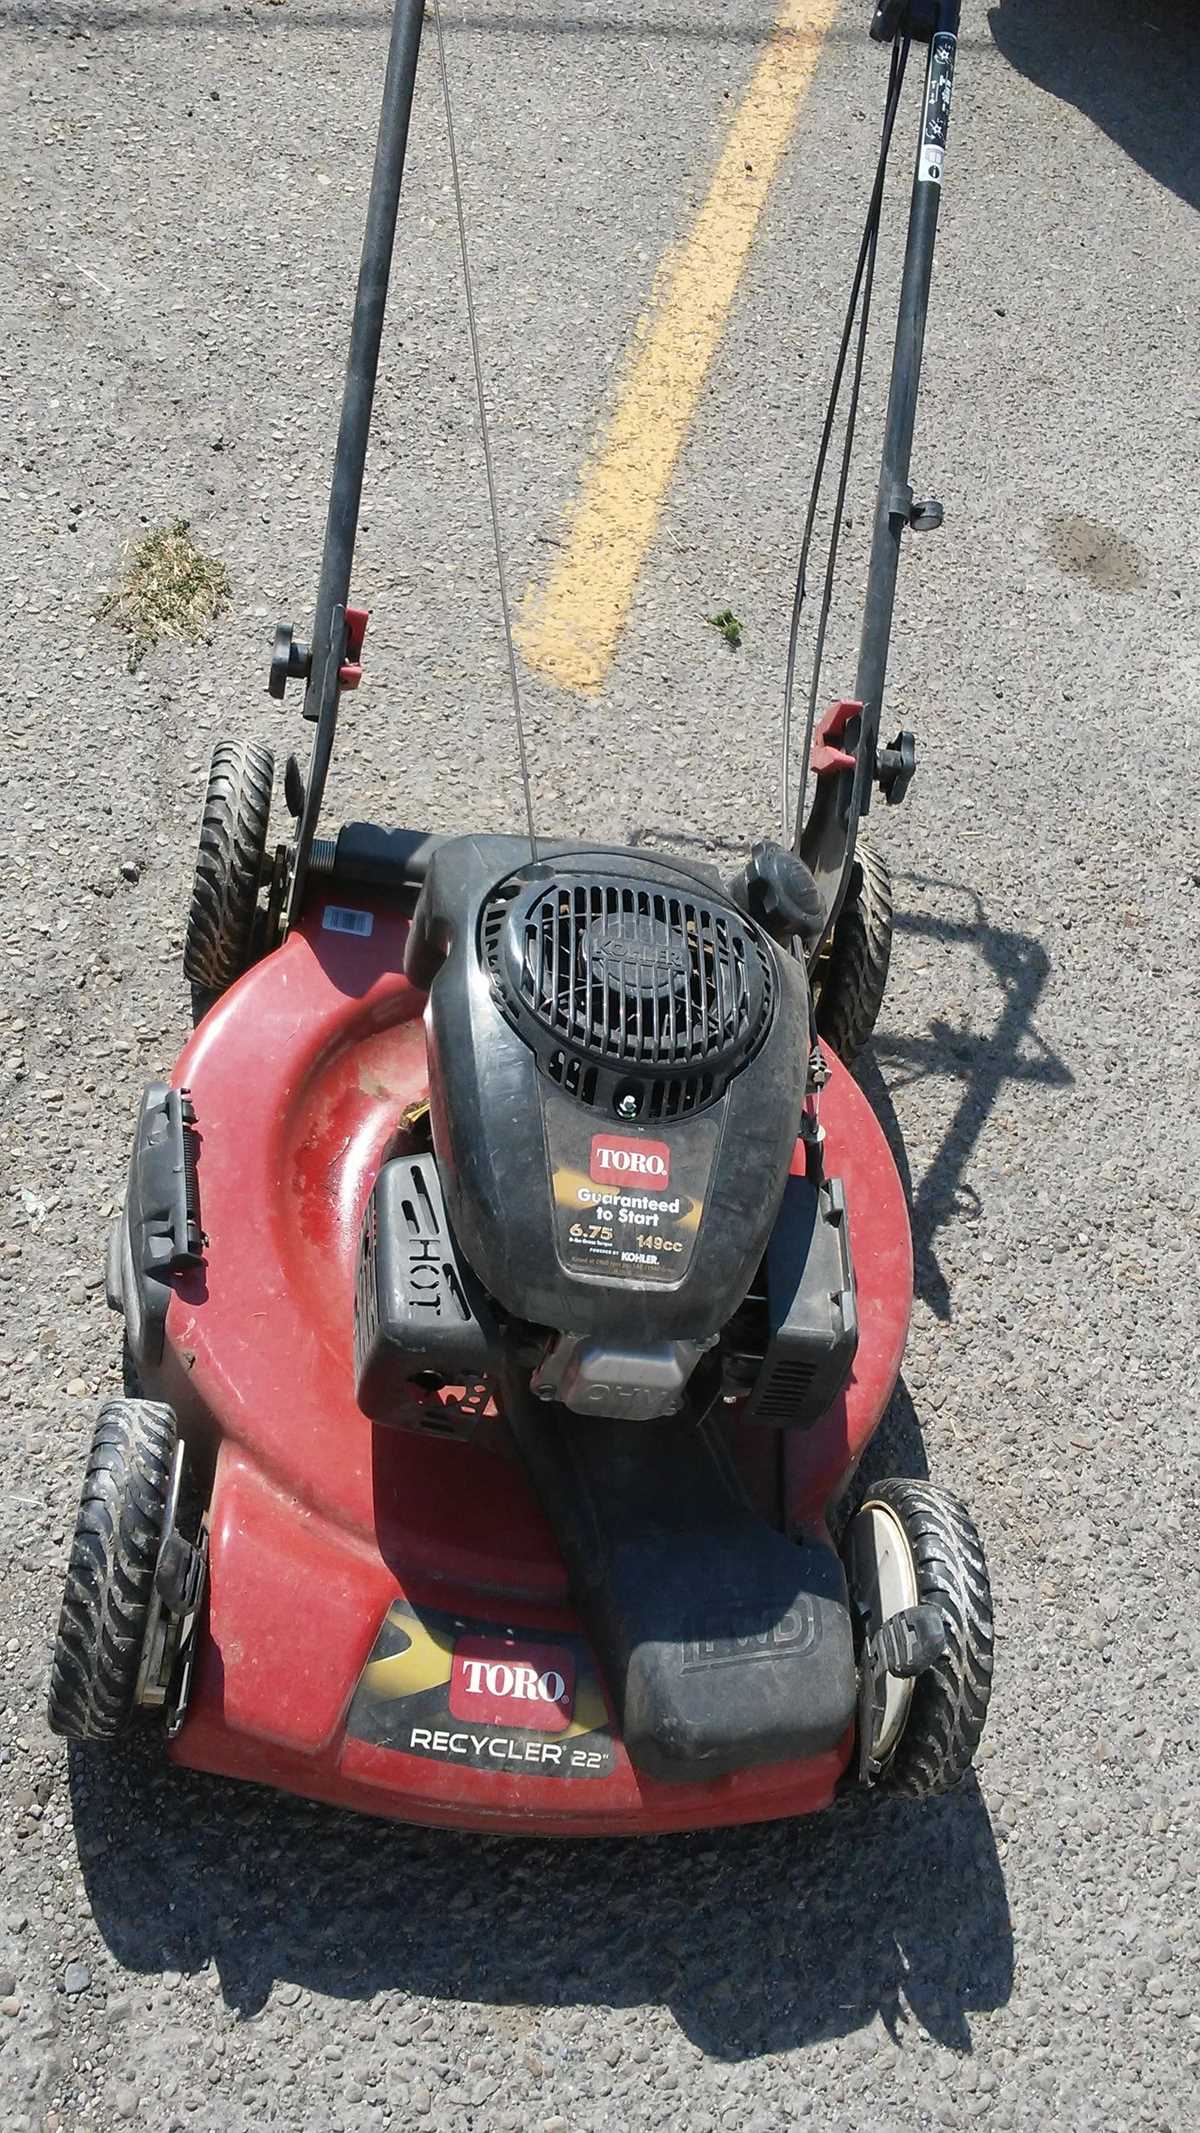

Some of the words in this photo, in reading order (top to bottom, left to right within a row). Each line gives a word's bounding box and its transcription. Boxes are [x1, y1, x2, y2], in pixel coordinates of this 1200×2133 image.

[577, 1188, 680, 1214] Guaranteed
[596, 1206, 614, 1221] to
[618, 1209, 660, 1227] Start
[569, 1223, 613, 1241] 6.75
[636, 1234, 684, 1253] 149cc
[409, 1239, 441, 1316] HOT
[570, 1750, 610, 1770] 22"
